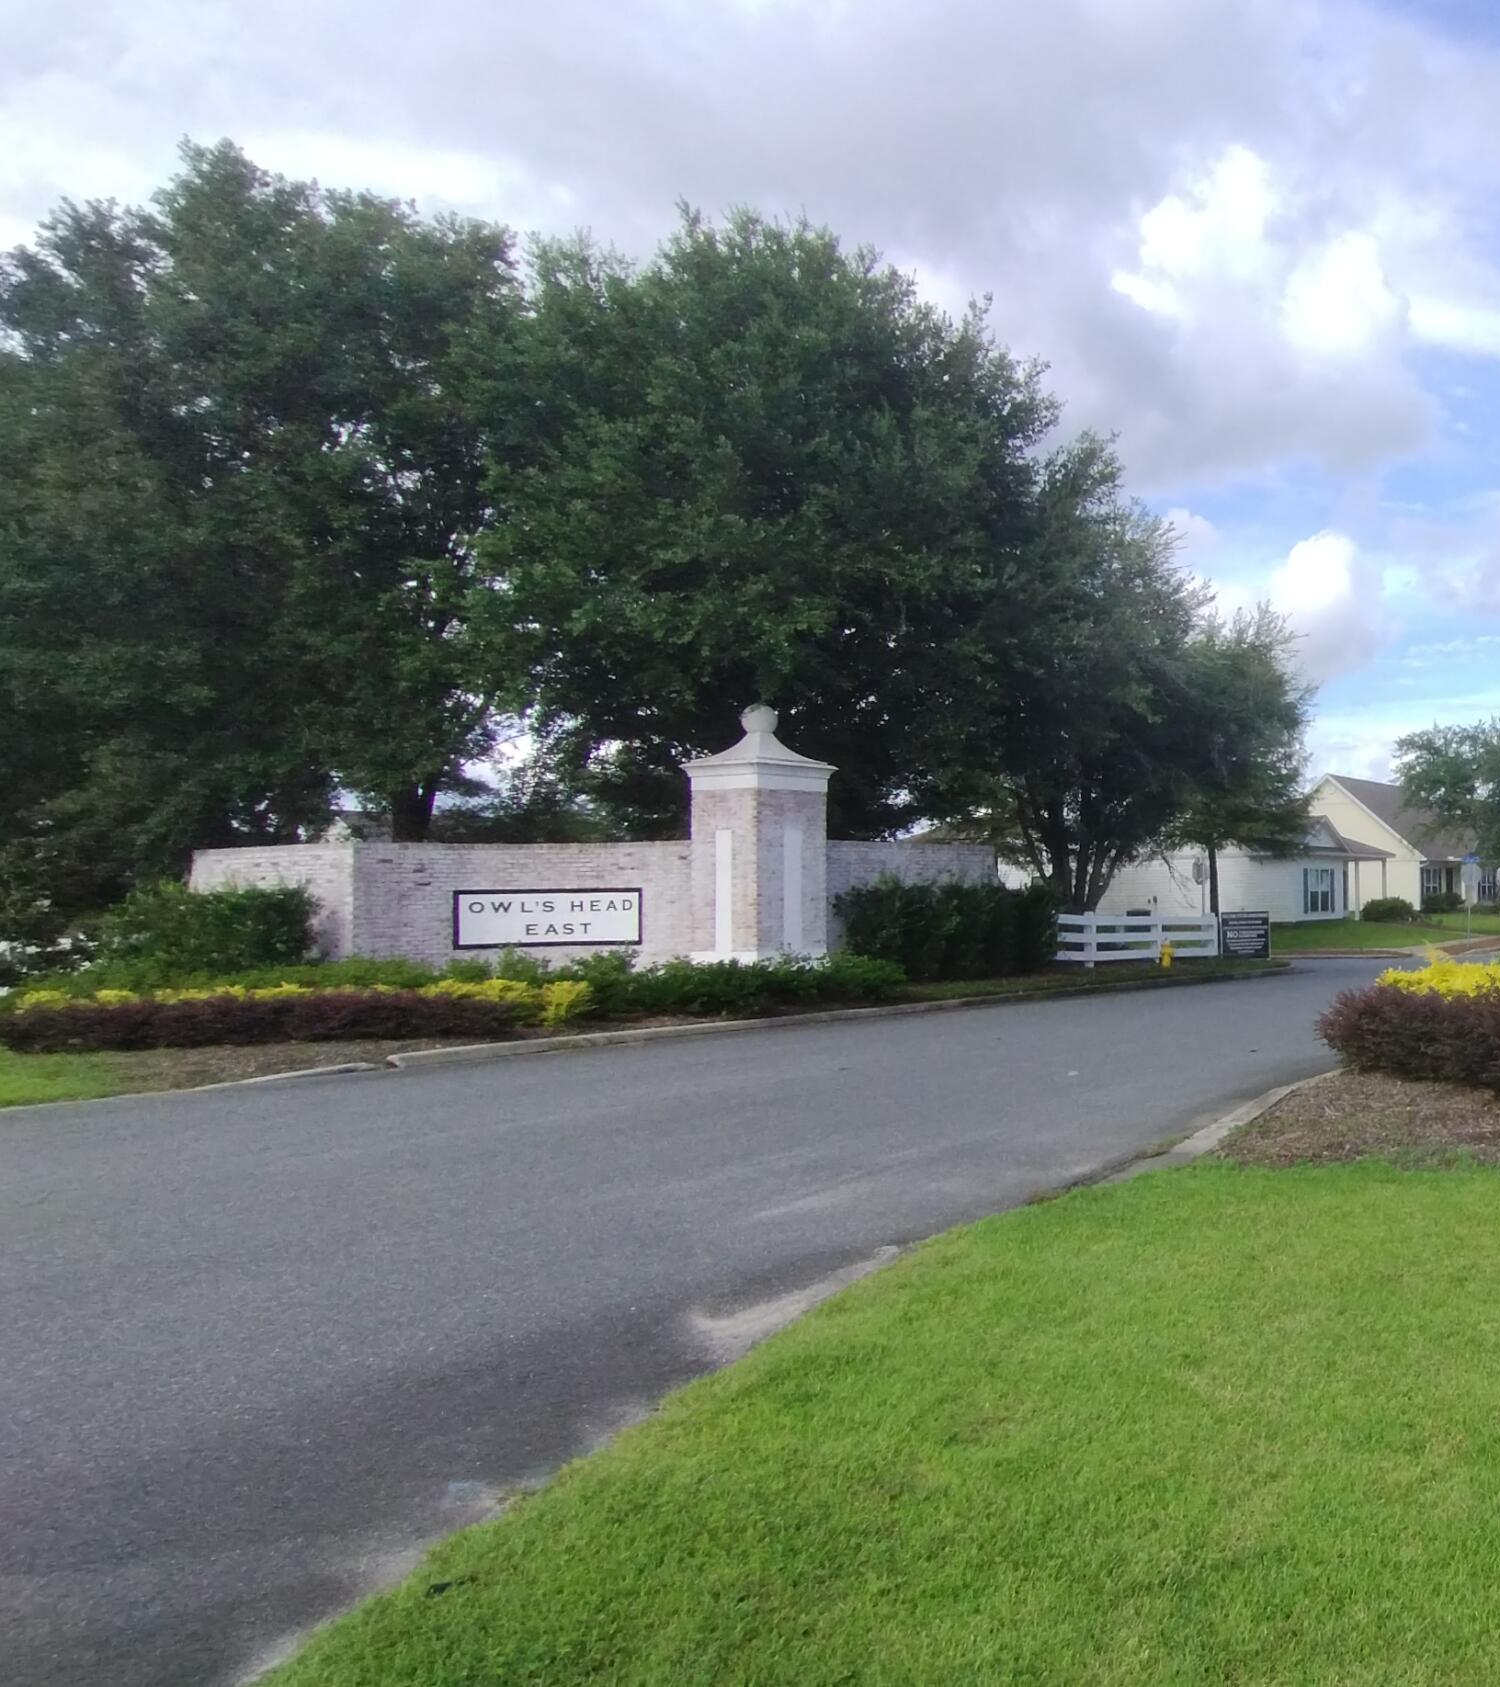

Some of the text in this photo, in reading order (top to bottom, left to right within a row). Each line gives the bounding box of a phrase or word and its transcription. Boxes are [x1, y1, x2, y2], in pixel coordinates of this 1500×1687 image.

[468, 899, 633, 914] OWL'S HEAD
[525, 922, 592, 936] EAST
